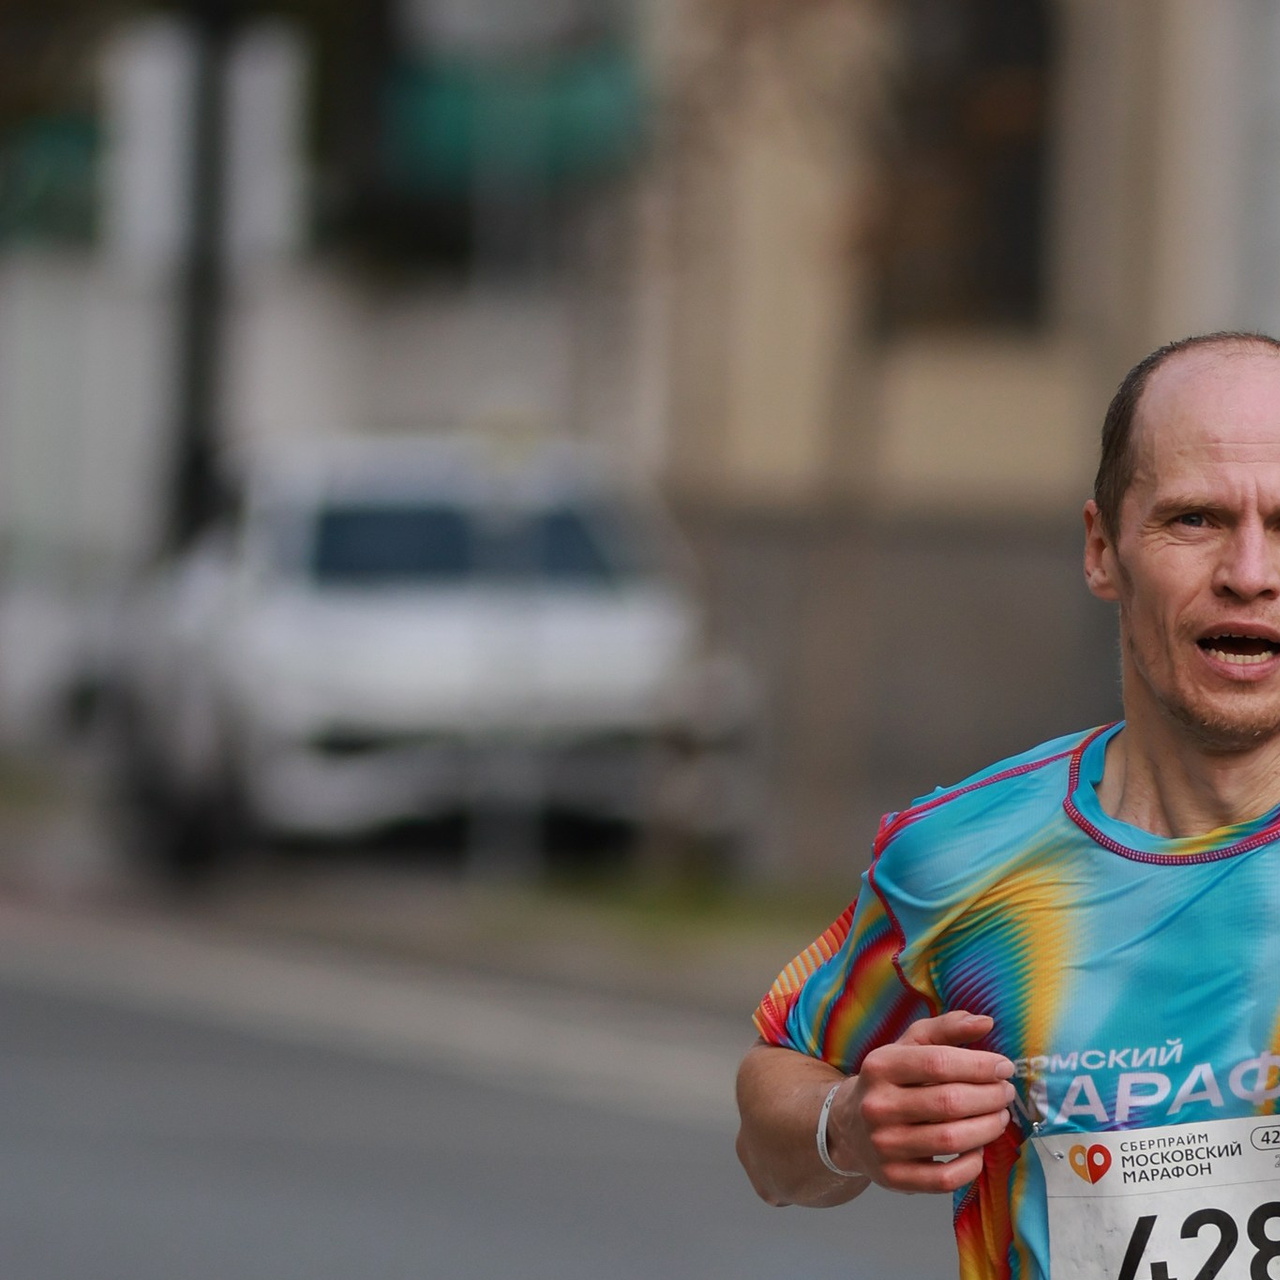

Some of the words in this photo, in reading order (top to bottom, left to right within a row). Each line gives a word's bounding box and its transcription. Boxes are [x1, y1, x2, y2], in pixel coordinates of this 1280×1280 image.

[1013, 1037, 1184, 1078] ЕРМСКИЙ
[1120, 1133, 1209, 1152] СБЕРПРАЙМ
[1121, 1141, 1242, 1168] МОСКОВСКИЙ
[1123, 1162, 1212, 1184] МАРАФОН
